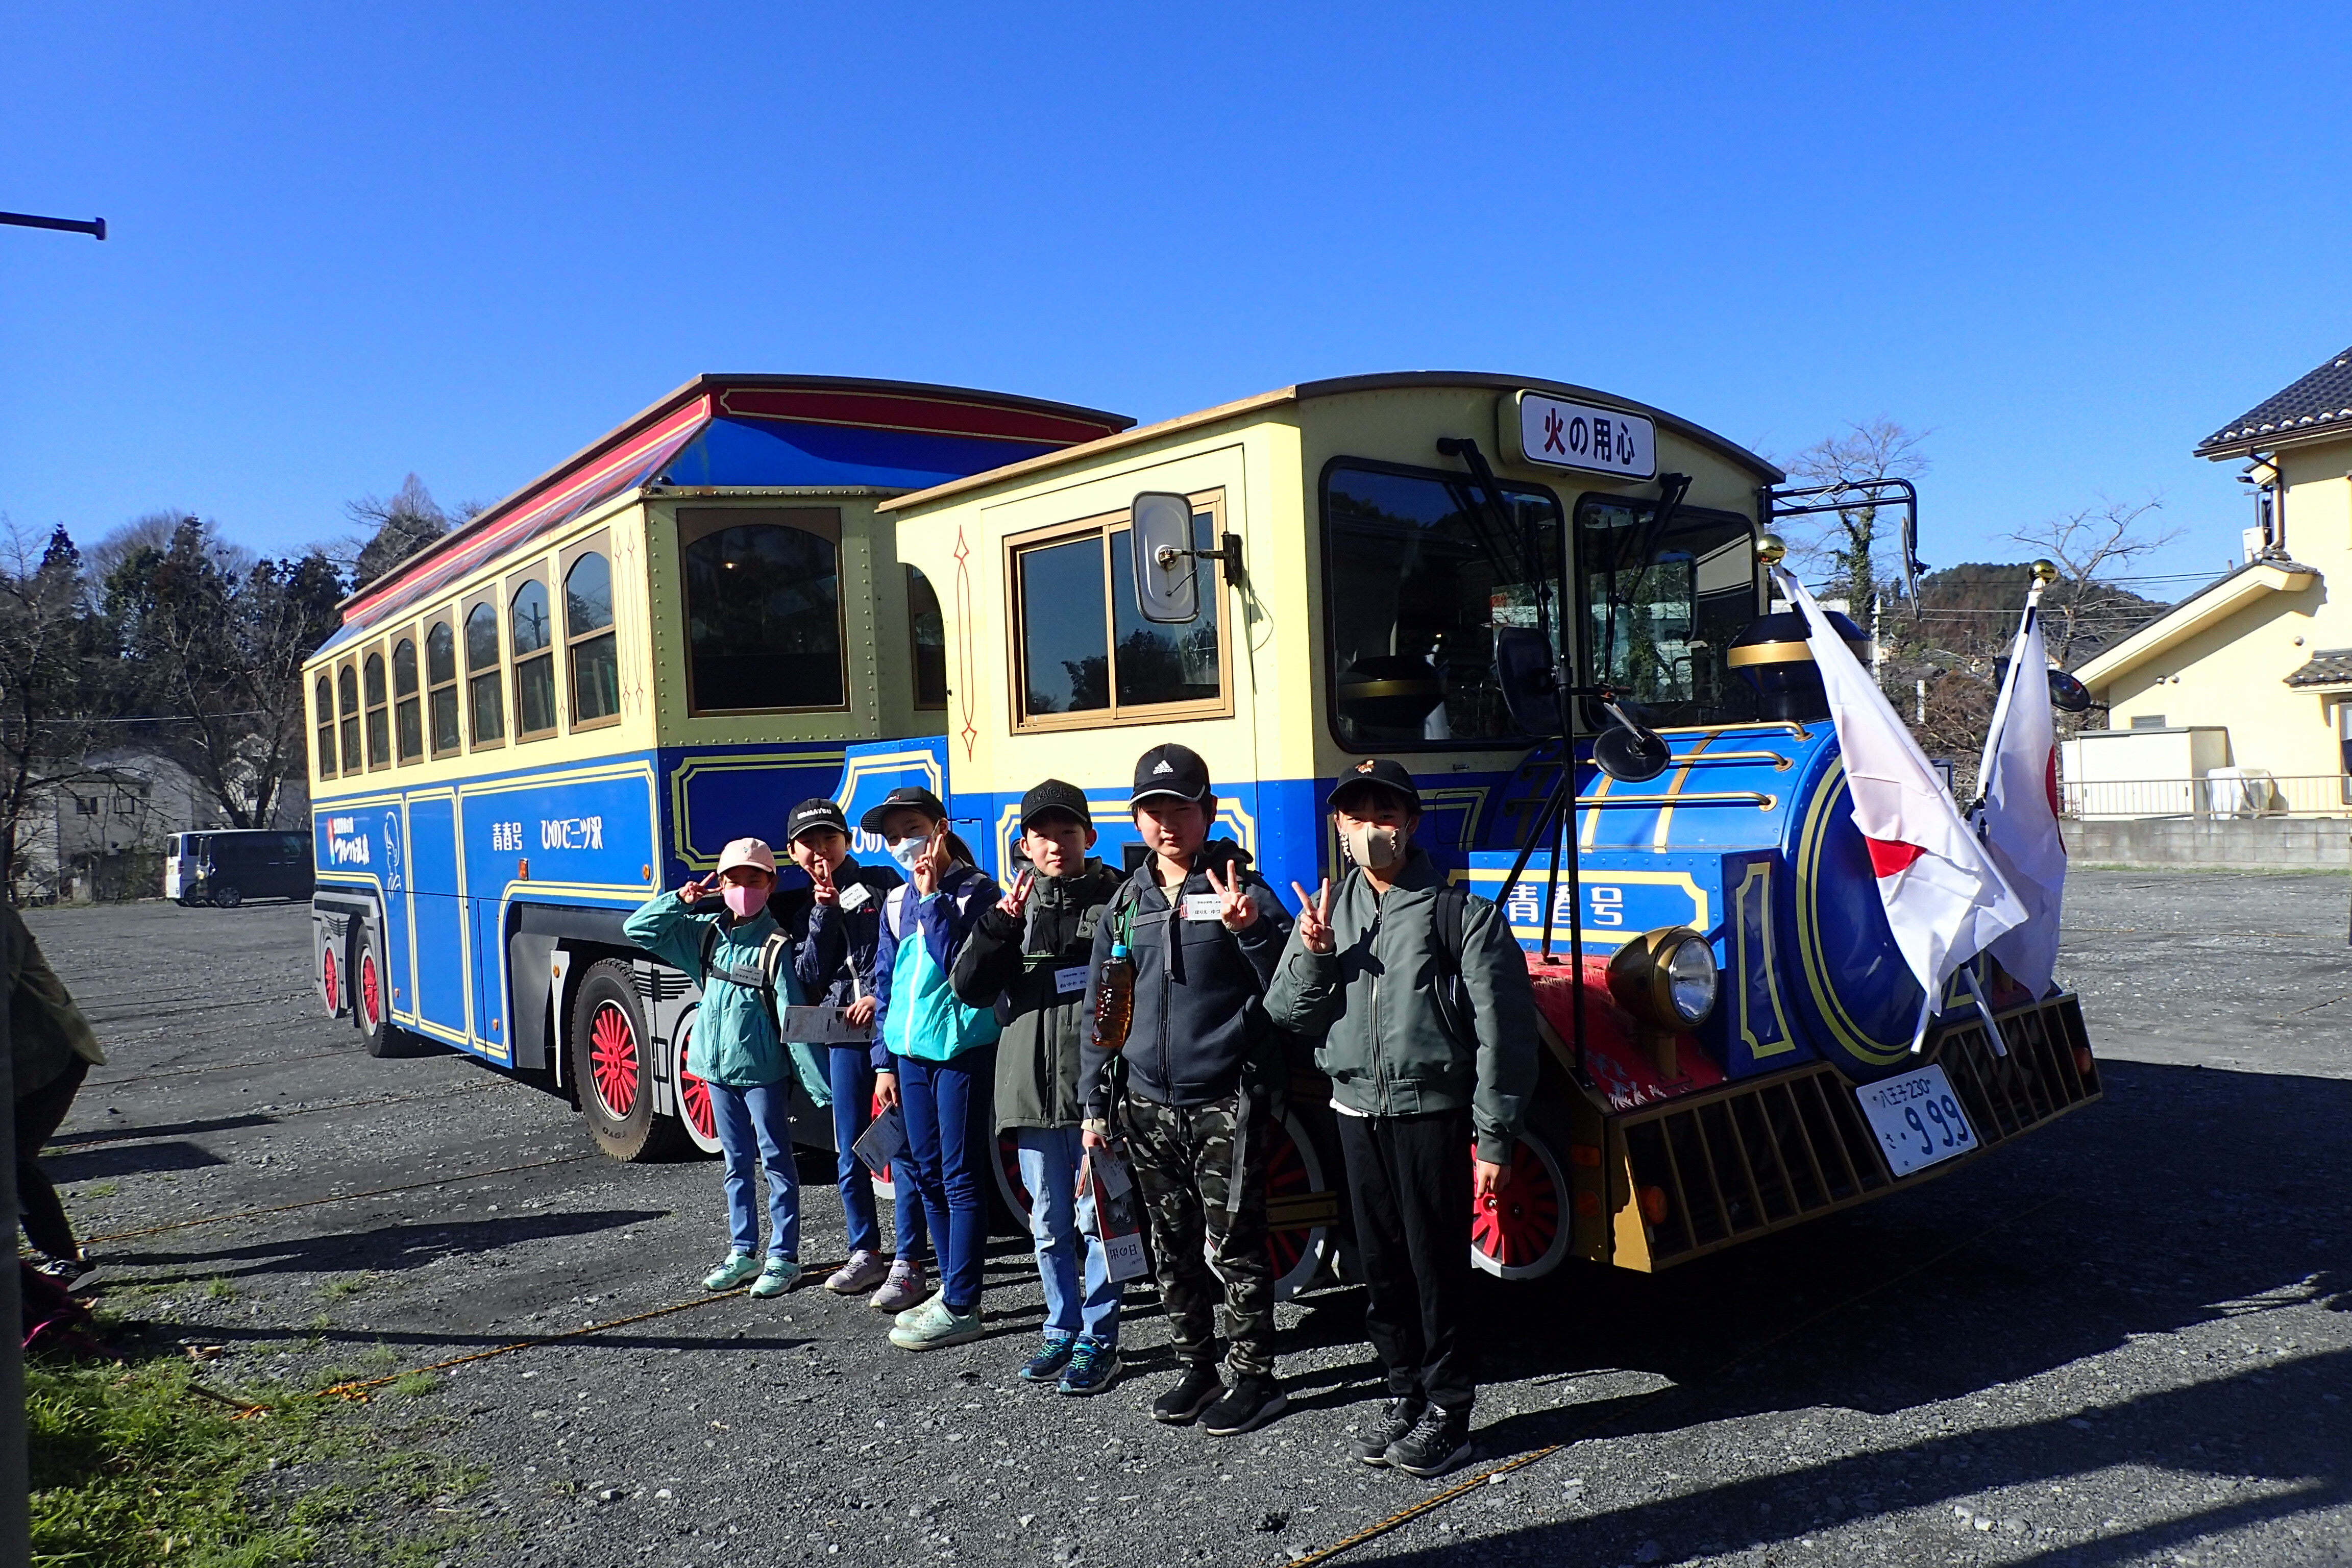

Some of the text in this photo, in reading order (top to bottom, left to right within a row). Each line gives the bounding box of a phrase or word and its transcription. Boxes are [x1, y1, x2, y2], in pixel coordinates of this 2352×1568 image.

[1544, 408, 1635, 465] 火の用心
[797, 807, 831, 820] KOMATSU
[493, 816, 603, 851] 青春号 ひので三ツ沢
